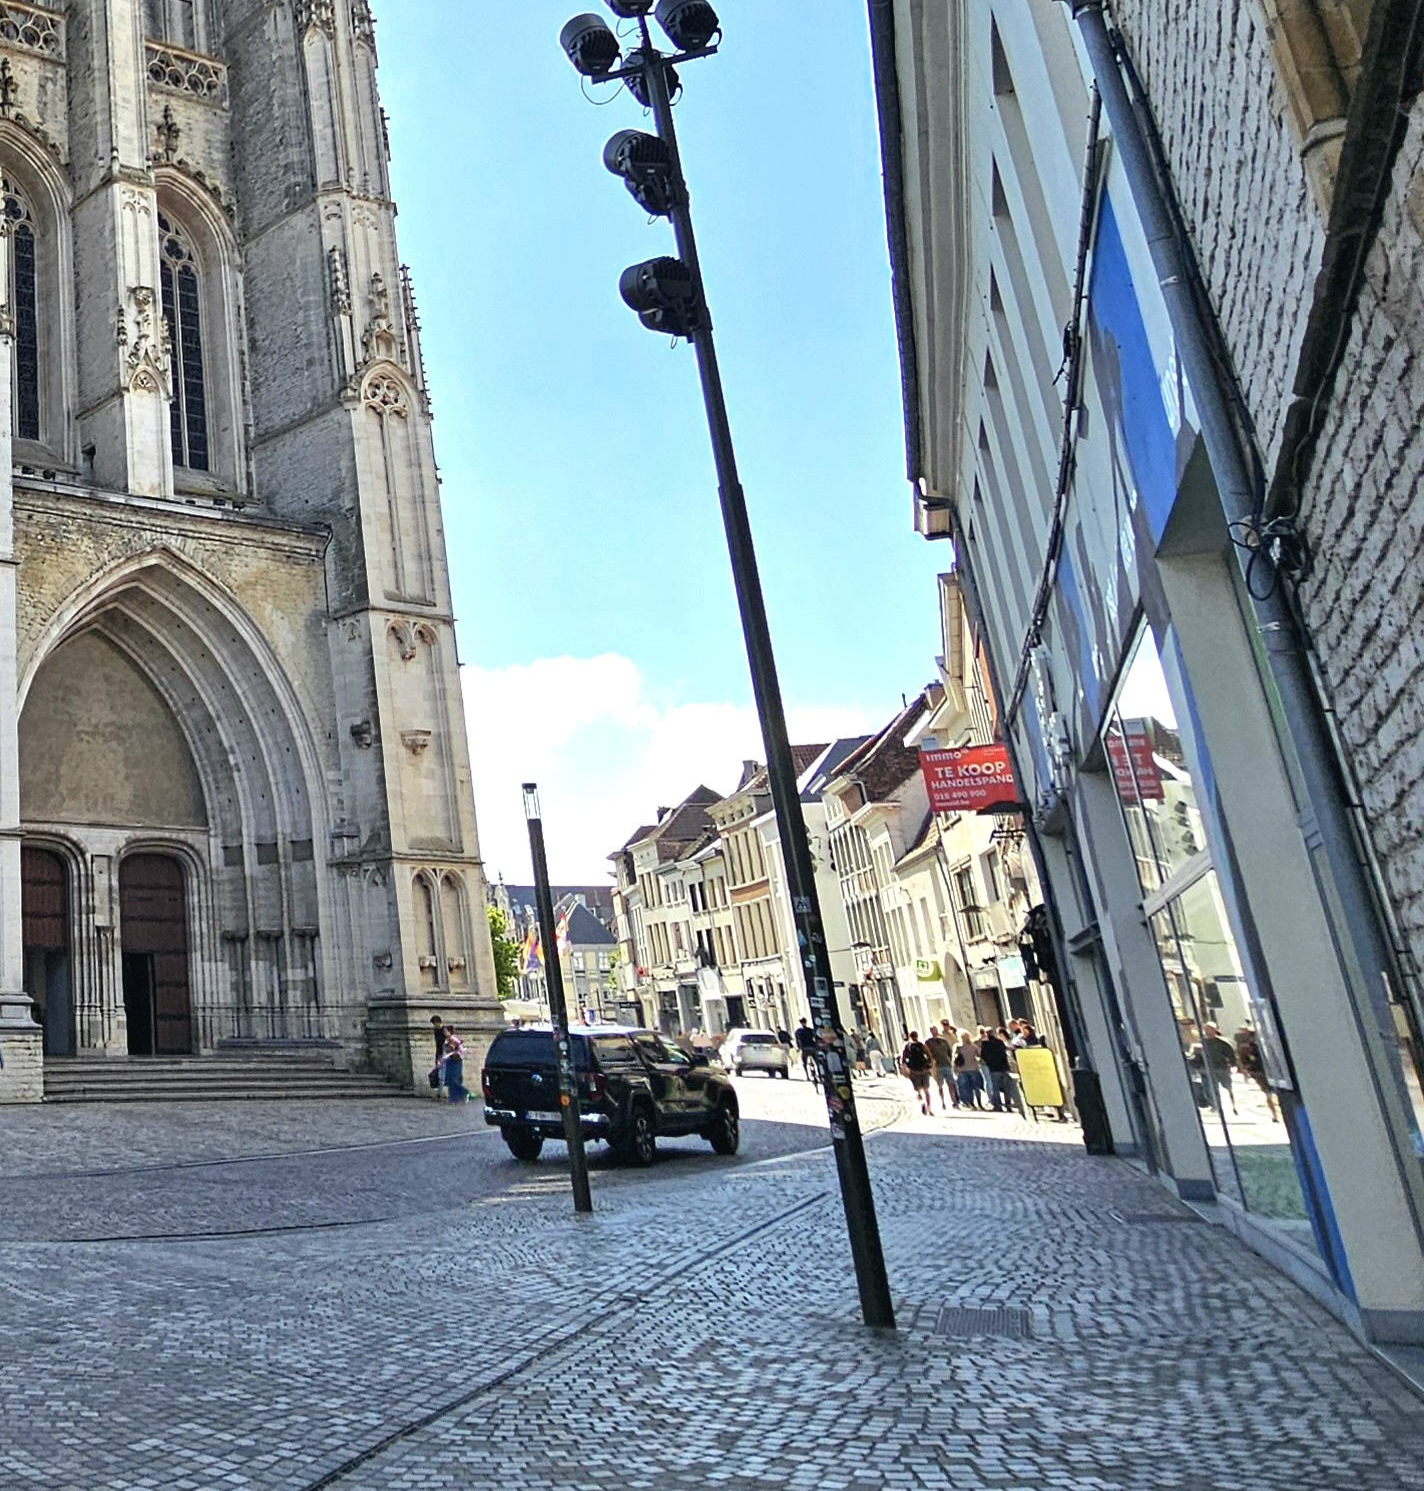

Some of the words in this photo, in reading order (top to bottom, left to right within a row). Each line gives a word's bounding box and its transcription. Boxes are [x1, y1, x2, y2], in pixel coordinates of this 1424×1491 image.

[935, 767, 954, 779] TE
[957, 761, 1005, 777] KOOP
[931, 774, 1014, 789] HANDELSPAND
